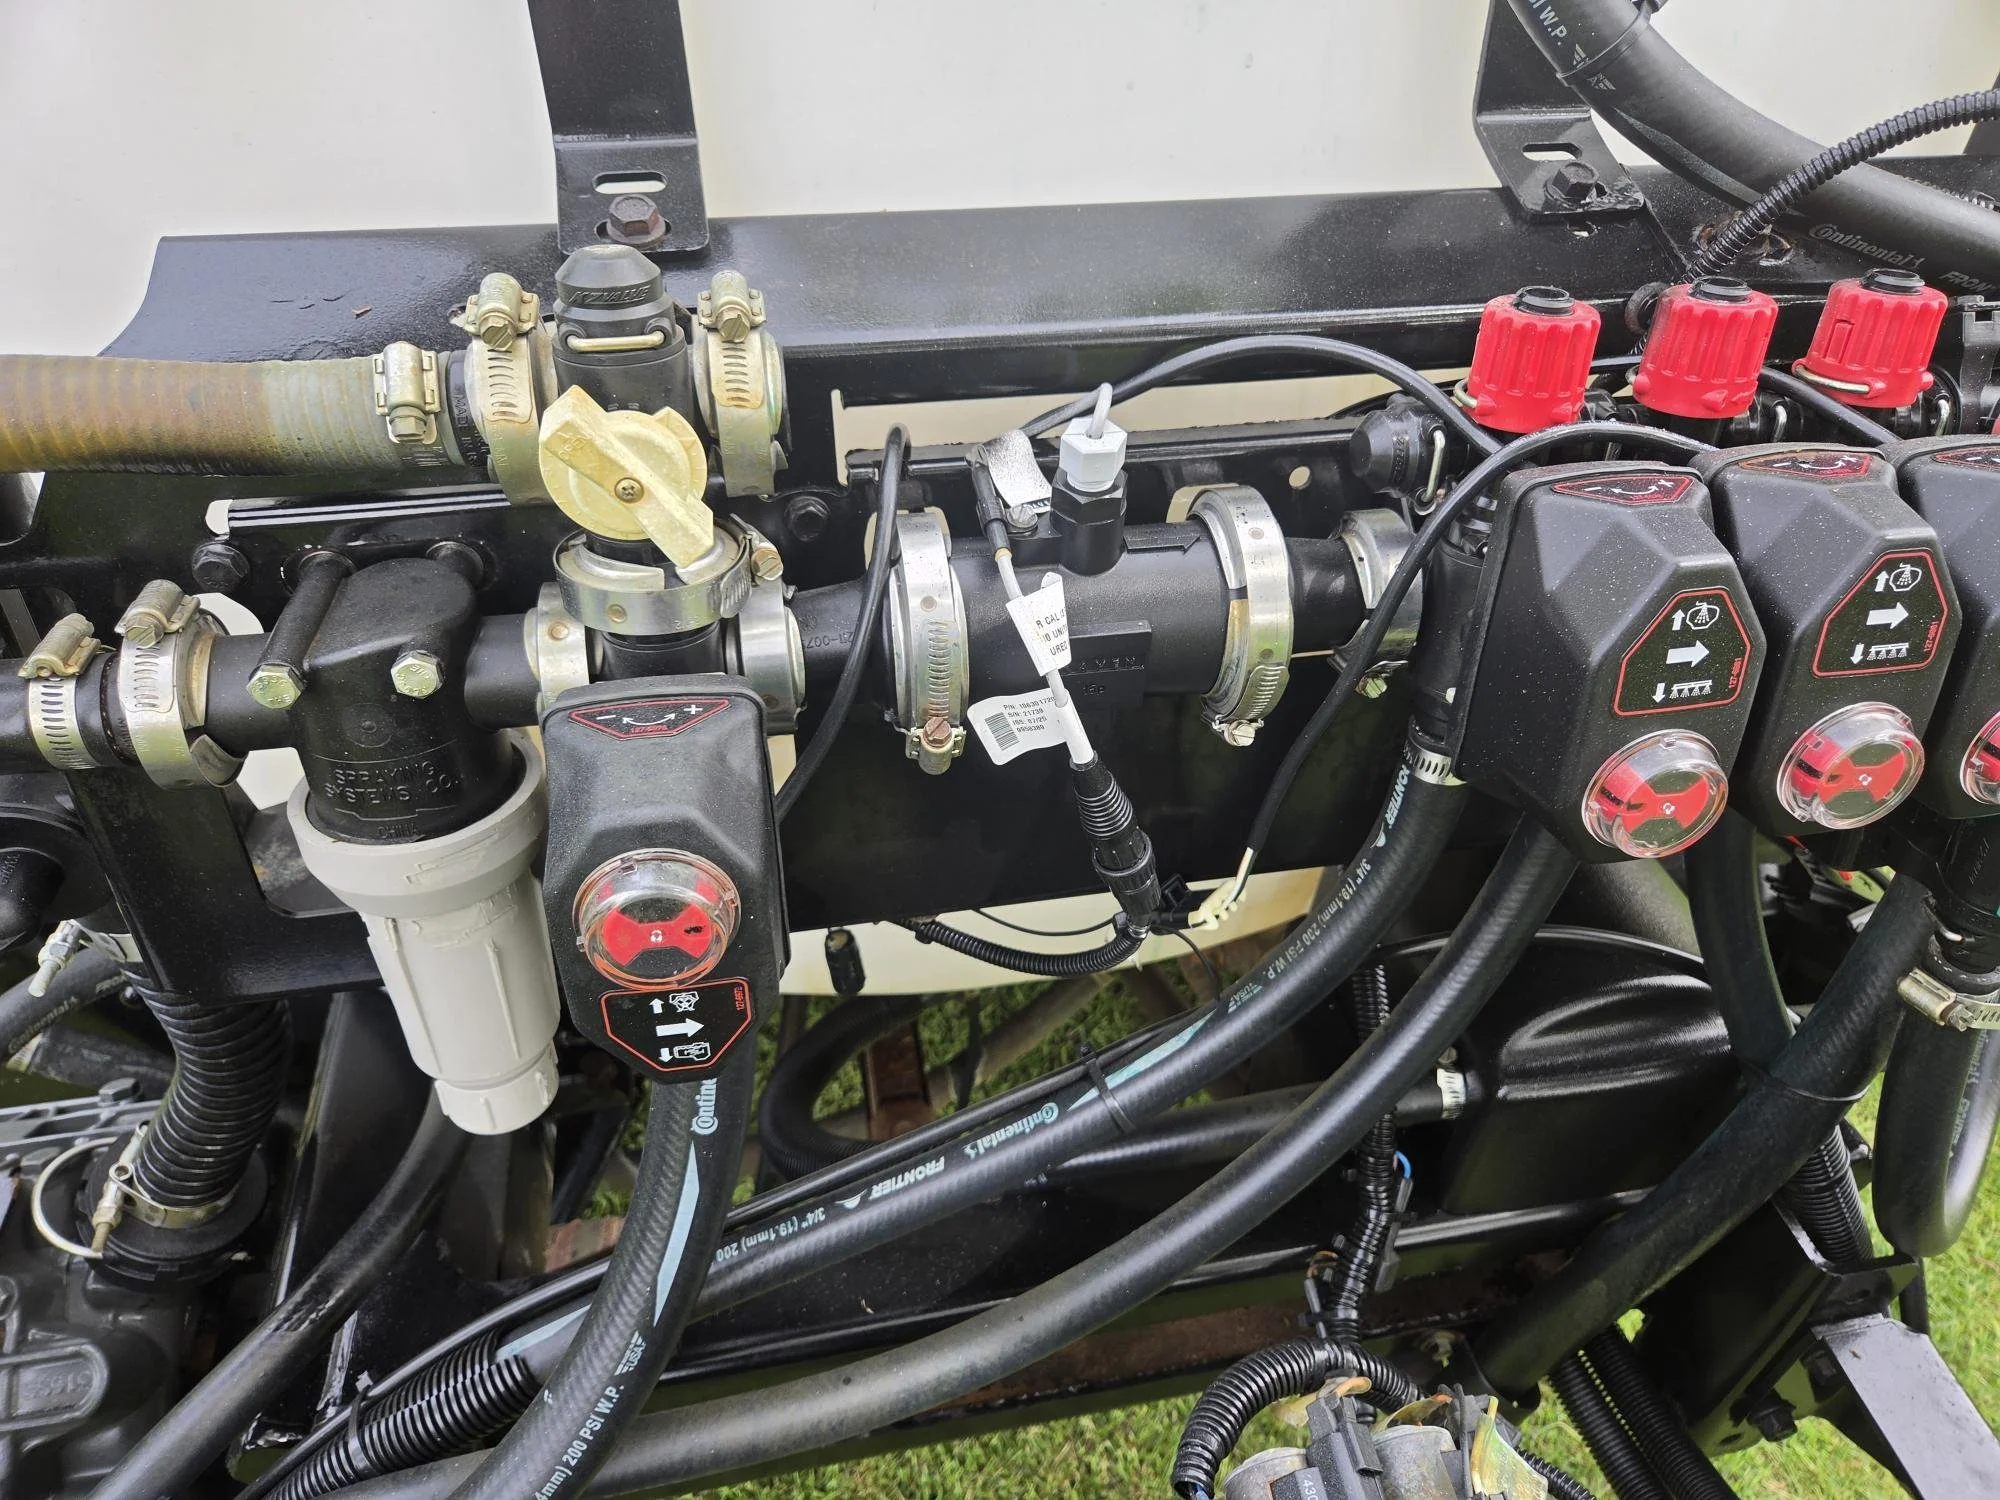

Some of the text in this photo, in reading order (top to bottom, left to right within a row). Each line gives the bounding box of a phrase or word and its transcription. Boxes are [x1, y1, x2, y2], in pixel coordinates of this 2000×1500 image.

[1540, 6, 1568, 46] W.P.
[1809, 223, 1914, 267] Continental
[1044, 612, 1060, 625] CAL
[1003, 703, 1018, 711] P/N:
[324, 774, 460, 804] SYSTEMS CO.
[335, 761, 435, 784] SPRAYING
[1316, 876, 1358, 925] (19.1mm)
[980, 1102, 1059, 1153] Continental
[868, 1155, 945, 1201] FRONTIER
[715, 1206, 826, 1263] 3/4" (19.1mm) 200
[562, 1439, 588, 1467] 200
[578, 1411, 606, 1441] PSI
[595, 1384, 625, 1416] W.P.
